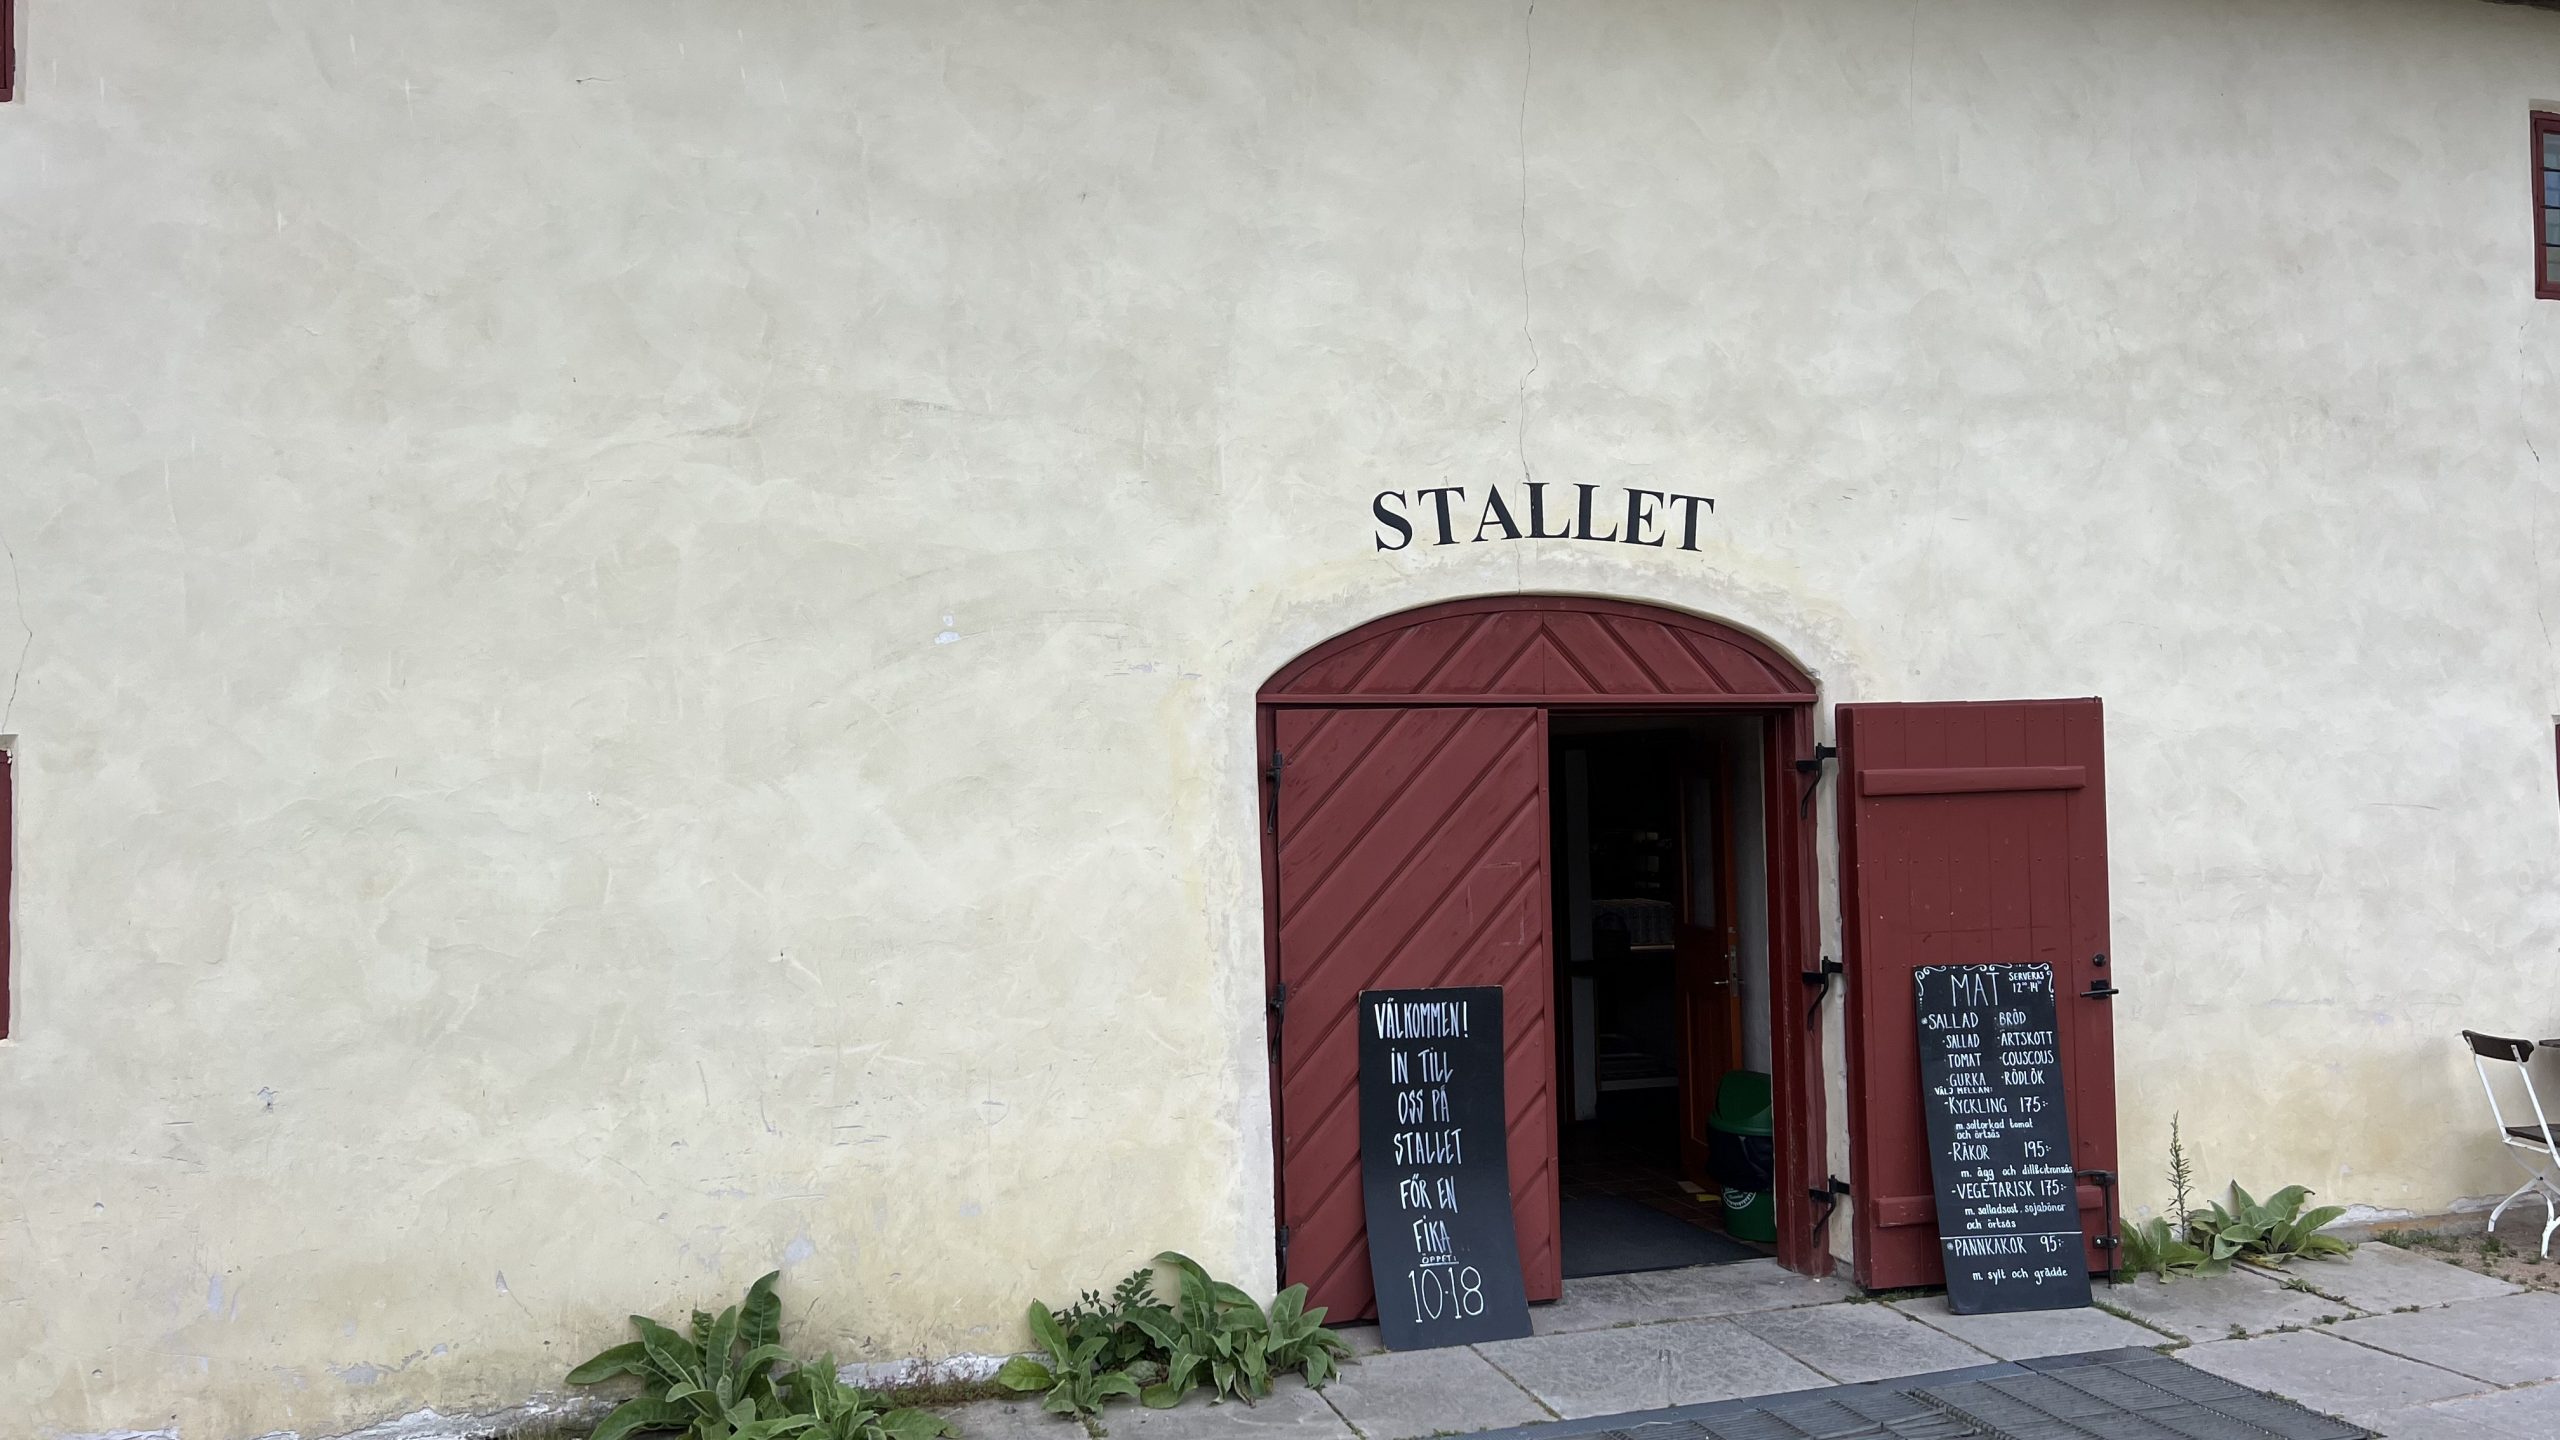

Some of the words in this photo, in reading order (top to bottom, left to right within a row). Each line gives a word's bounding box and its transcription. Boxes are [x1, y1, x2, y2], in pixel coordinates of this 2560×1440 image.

[1373, 482, 1715, 552] STALLET
[2008, 971, 2045, 981] SERVERAS
[1951, 972, 2000, 1007] MAT
[1374, 997, 1469, 1040] VÄLKOMMEN!
[1928, 1012, 1979, 1030] SALLAD
[1999, 1008, 2027, 1026] BRÖD
[1946, 1033, 1980, 1049] SALLAD
[2000, 1029, 2053, 1046] ÄRTSKOTT
[1391, 1047, 1409, 1085] IN
[1418, 1047, 1454, 1083] TILL
[1947, 1053, 1981, 1069] TOMAT
[2002, 1050, 2054, 1066] COUSCOUS
[1949, 1072, 1986, 1087] GURKA
[2004, 1068, 2045, 1085] RÖDLÖK
[1397, 1089, 1424, 1125] OSS
[1432, 1084, 1450, 1122] PÅ
[2009, 1118, 2034, 1129] tomat
[1956, 1130, 1971, 1140] och
[1394, 1128, 1462, 1166] STALLET
[1977, 1166, 1995, 1182] ägg
[2002, 1164, 2017, 1176] och
[1400, 1173, 1432, 1210] FÖR
[1437, 1175, 1459, 1213] EN
[1966, 1218, 1982, 1230] och
[1412, 1215, 1452, 1254] FIKA
[1954, 1237, 2027, 1257] PANNKAKOR
[1987, 1268, 2007, 1285] sylt
[2011, 1267, 2029, 1279] och
[2034, 1266, 2069, 1286] grädde
